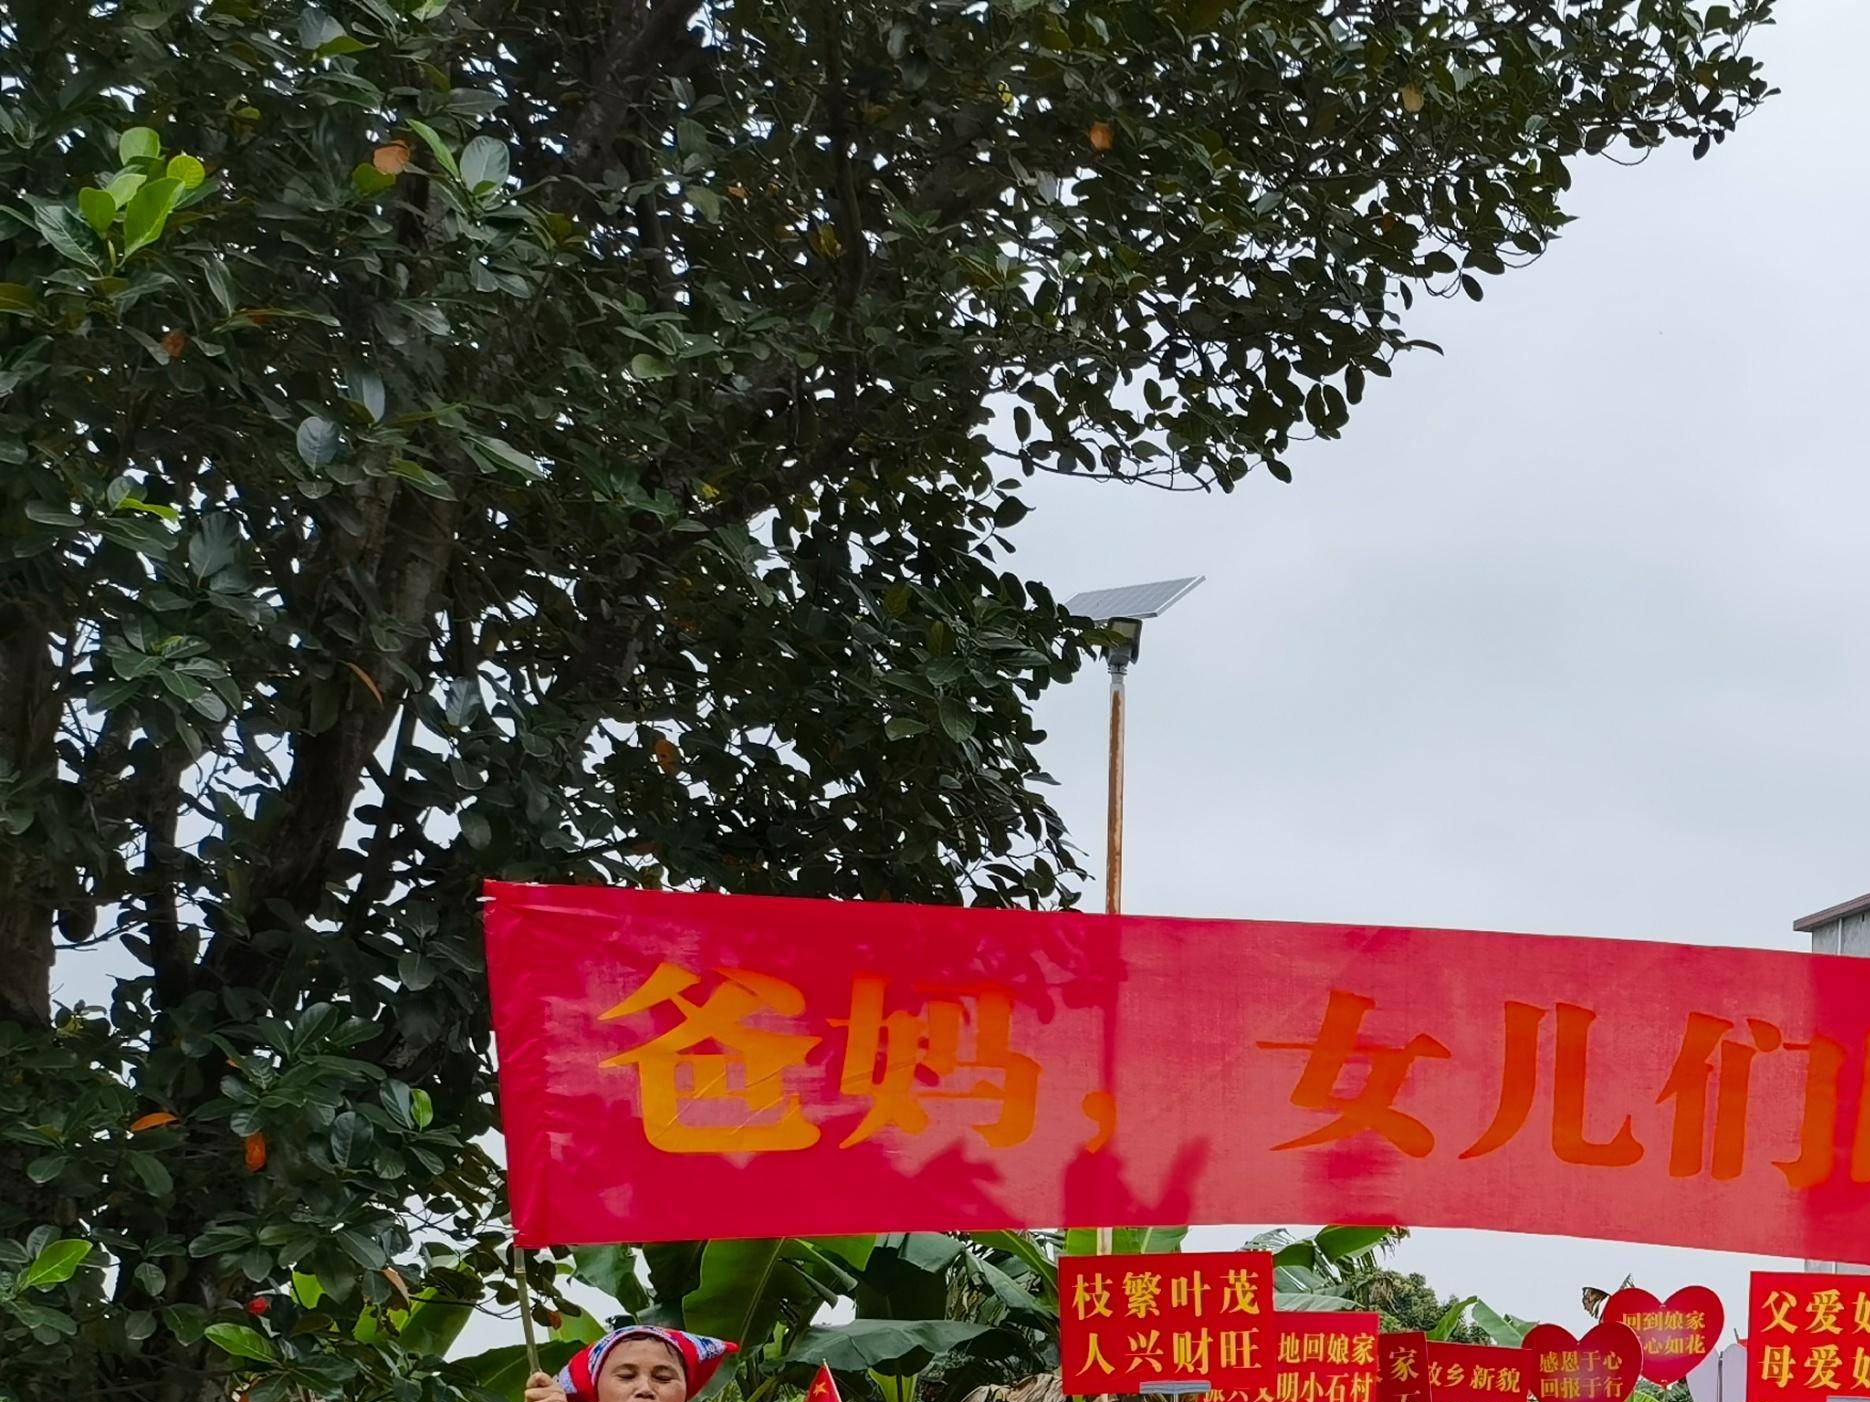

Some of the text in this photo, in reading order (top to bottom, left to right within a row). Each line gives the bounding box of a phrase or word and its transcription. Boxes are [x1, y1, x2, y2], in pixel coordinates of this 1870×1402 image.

[1072, 1269, 1260, 1320] 枝繁叶茂
[1623, 1310, 1705, 1331] 回到娘家
[1075, 1327, 1262, 1376] 人兴财旺
[1277, 1332, 1376, 1365] 地回娘家
[1638, 1334, 1706, 1355] 心如花
[1540, 1350, 1622, 1373] 感恩于心
[1540, 1376, 1623, 1399] 回报于行
